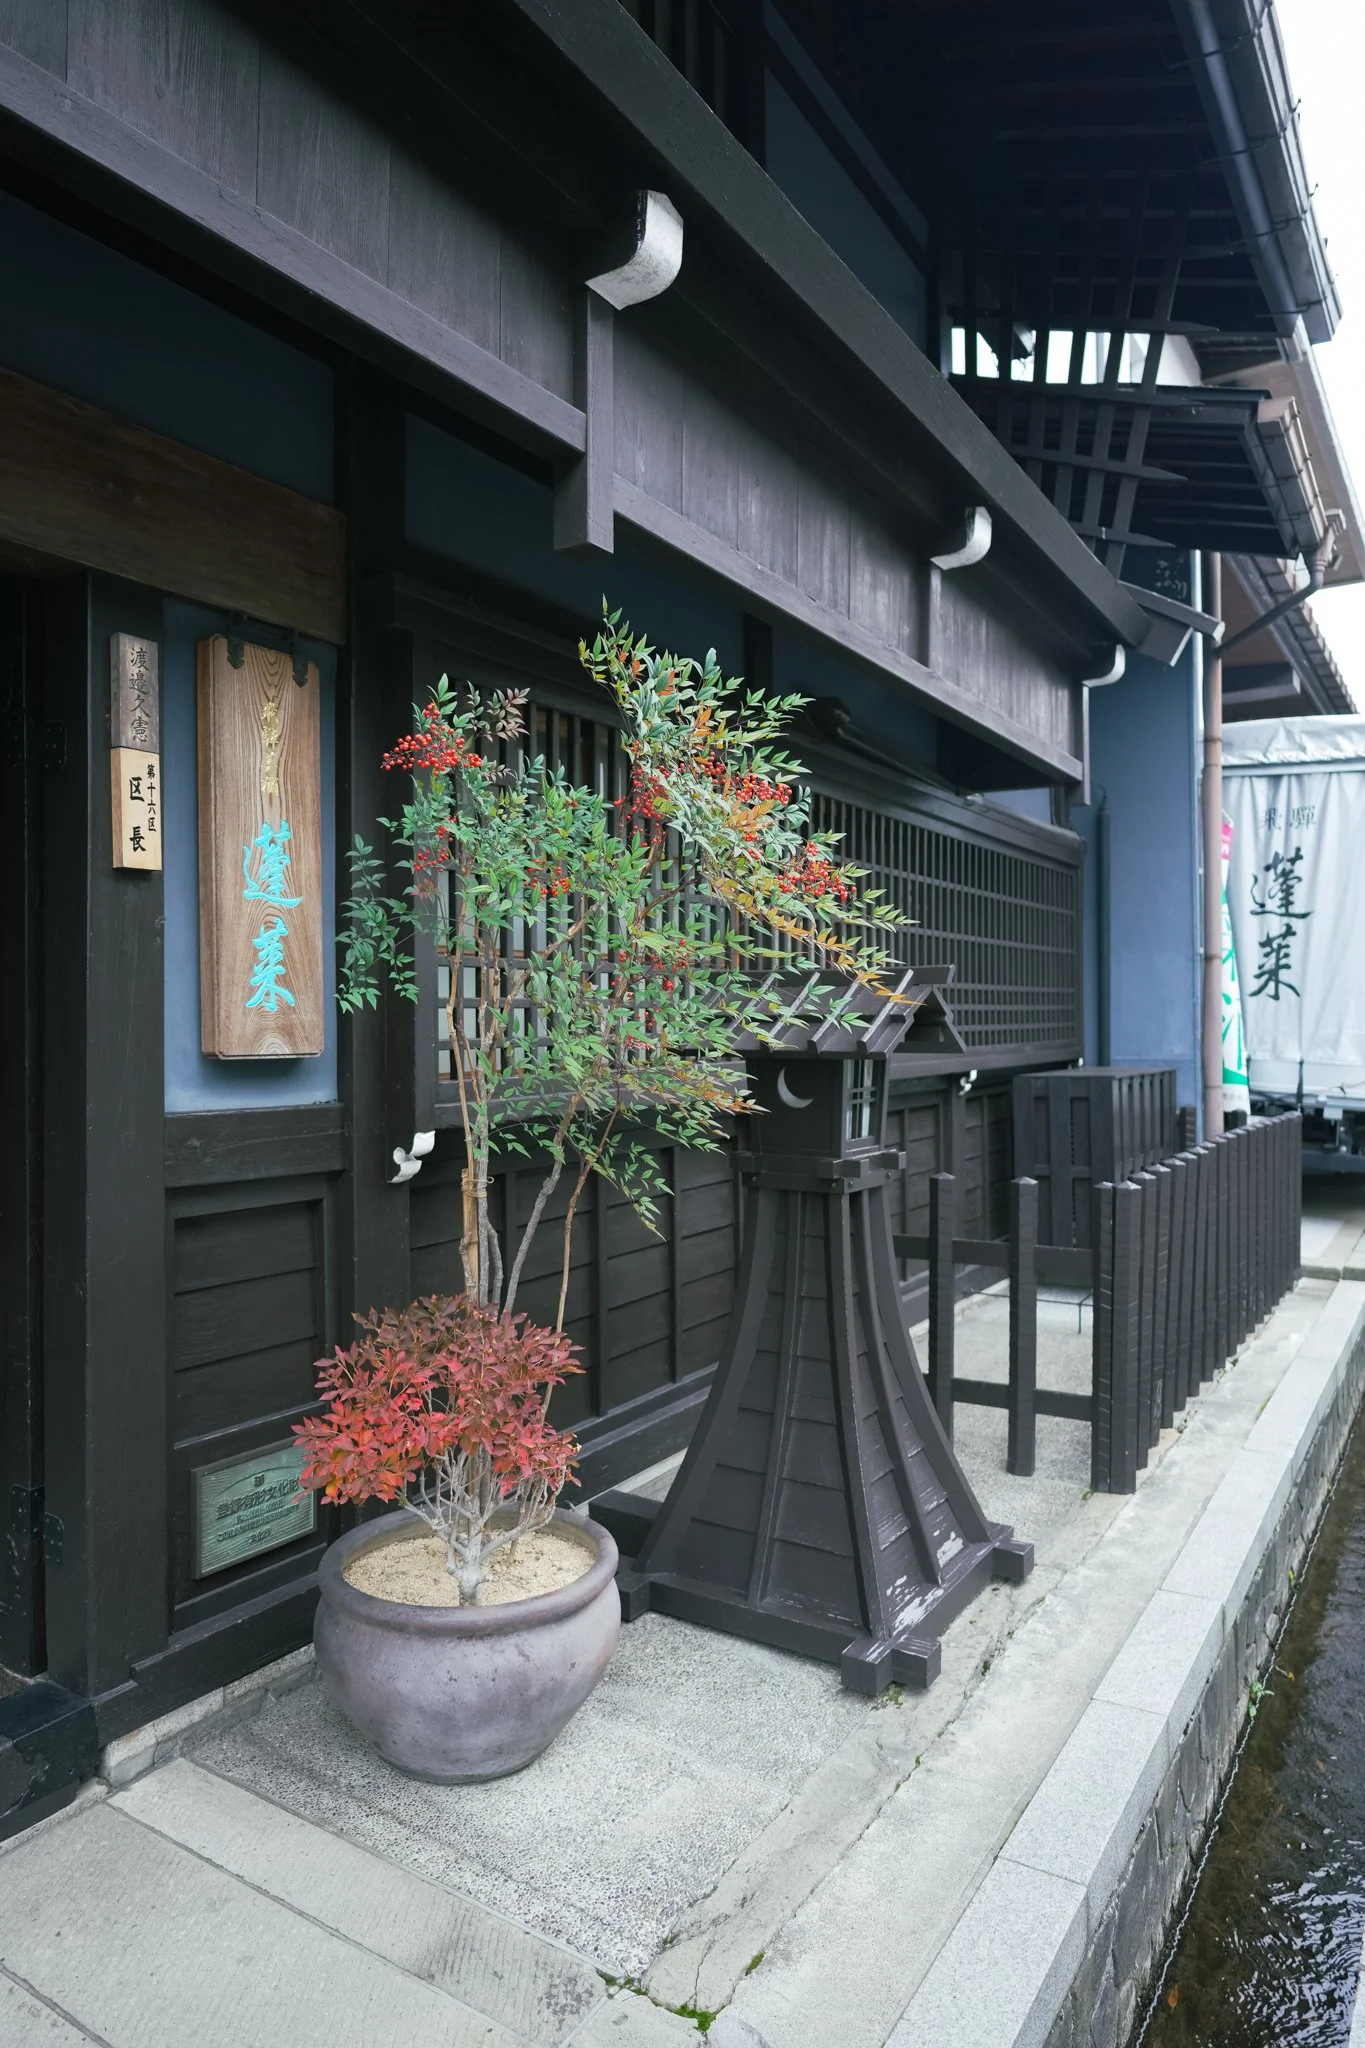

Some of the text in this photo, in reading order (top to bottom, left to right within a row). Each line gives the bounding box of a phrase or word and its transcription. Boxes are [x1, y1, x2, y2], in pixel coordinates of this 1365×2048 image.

[129, 776, 146, 853] 区長
[147, 763, 157, 832] 第十六区
